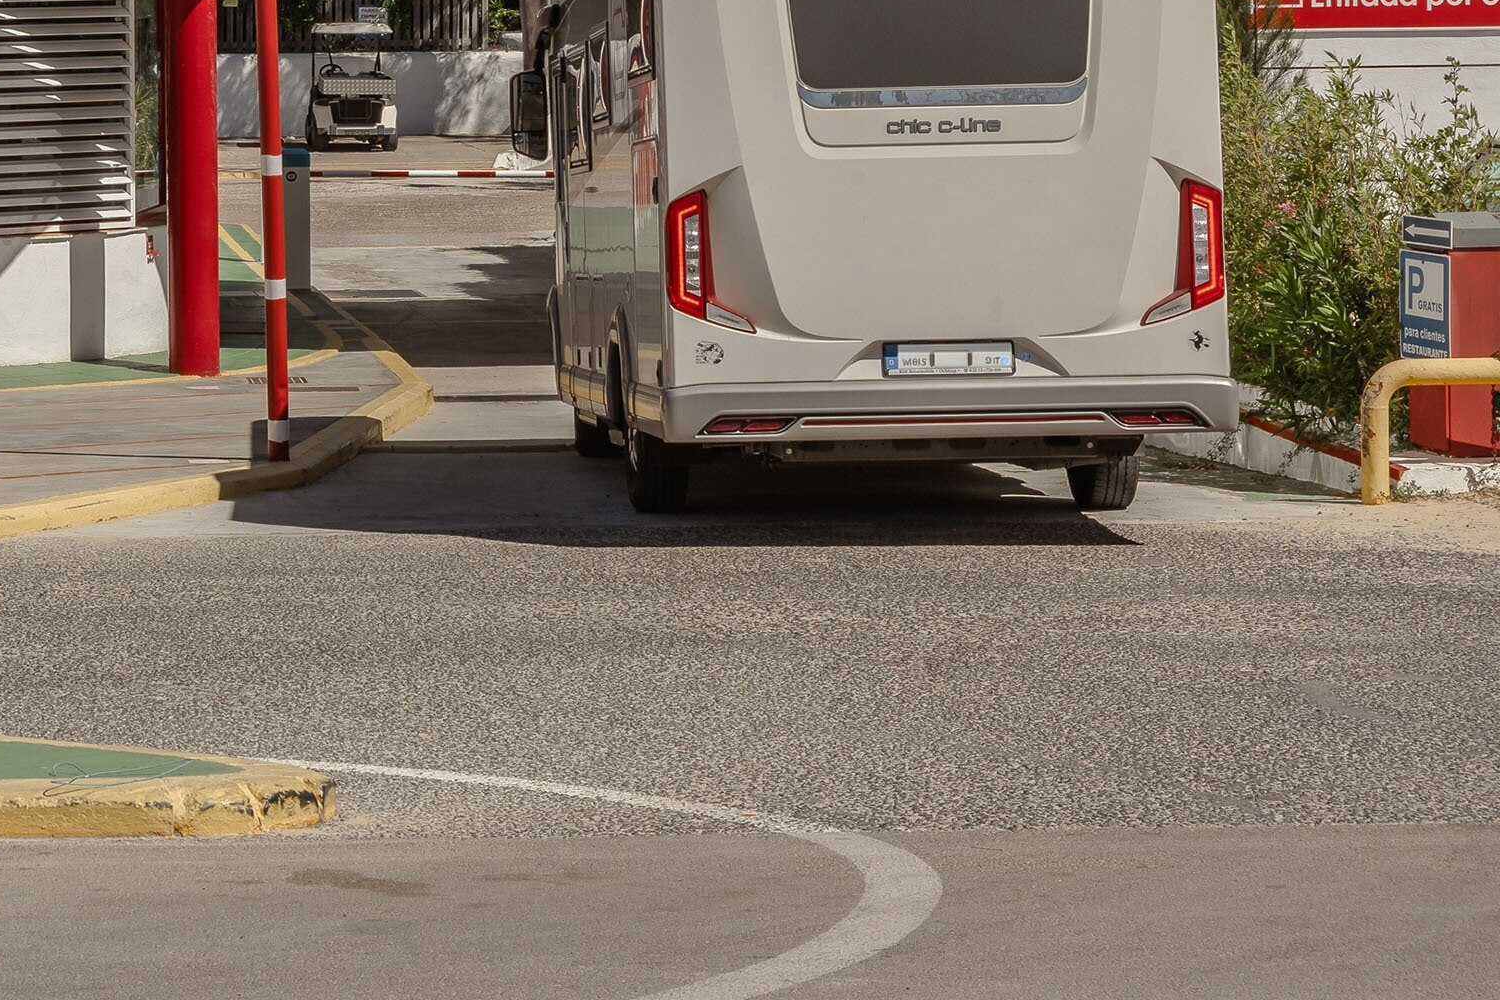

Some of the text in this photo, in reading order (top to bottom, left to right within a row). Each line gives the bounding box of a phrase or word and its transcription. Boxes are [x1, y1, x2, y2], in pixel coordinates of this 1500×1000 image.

[886, 117, 1001, 134] chic c-line
[1408, 265, 1425, 310] P
[1417, 300, 1443, 314] GRATIS
[1404, 327, 1446, 344] para clientes
